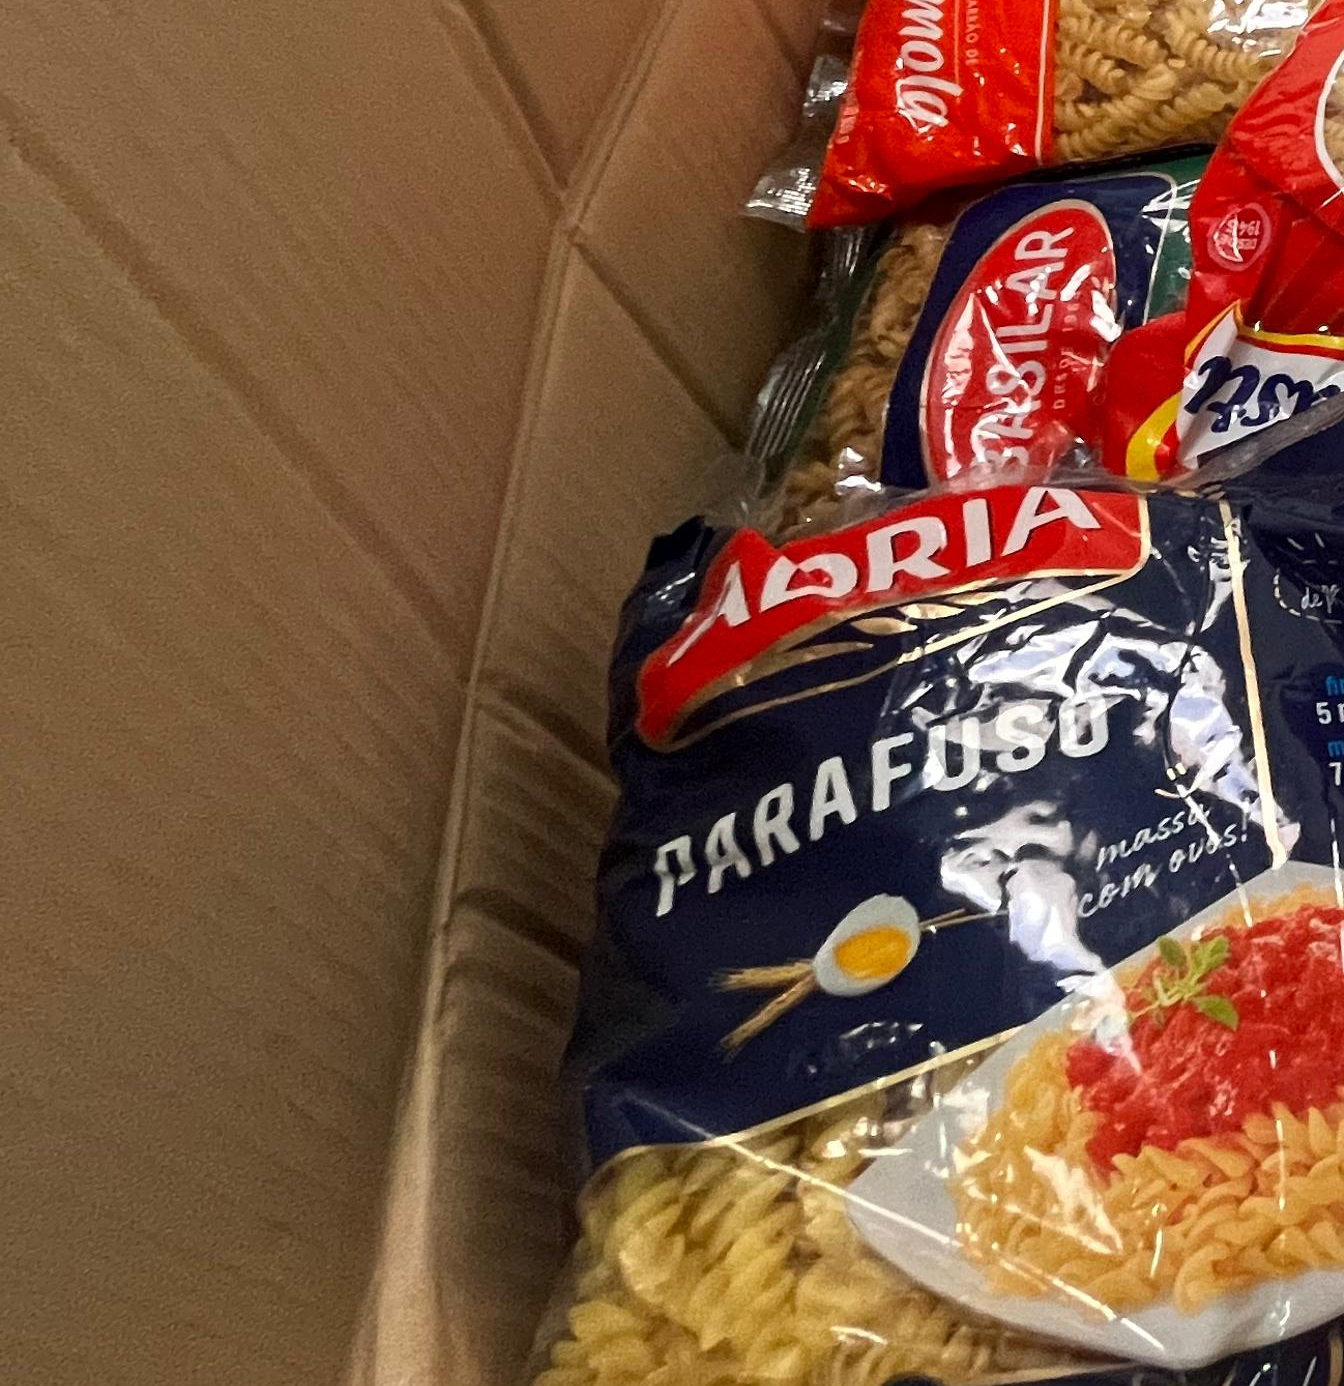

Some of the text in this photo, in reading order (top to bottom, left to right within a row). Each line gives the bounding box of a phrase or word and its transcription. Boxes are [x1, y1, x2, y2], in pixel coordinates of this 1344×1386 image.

[667, 486, 1103, 669] ADRIA
[1314, 700, 1333, 726] 5
[651, 690, 1118, 918] PARAFUSO
[1328, 761, 1344, 787] 7
[1095, 802, 1213, 872] massa
[1076, 861, 1161, 918] com
